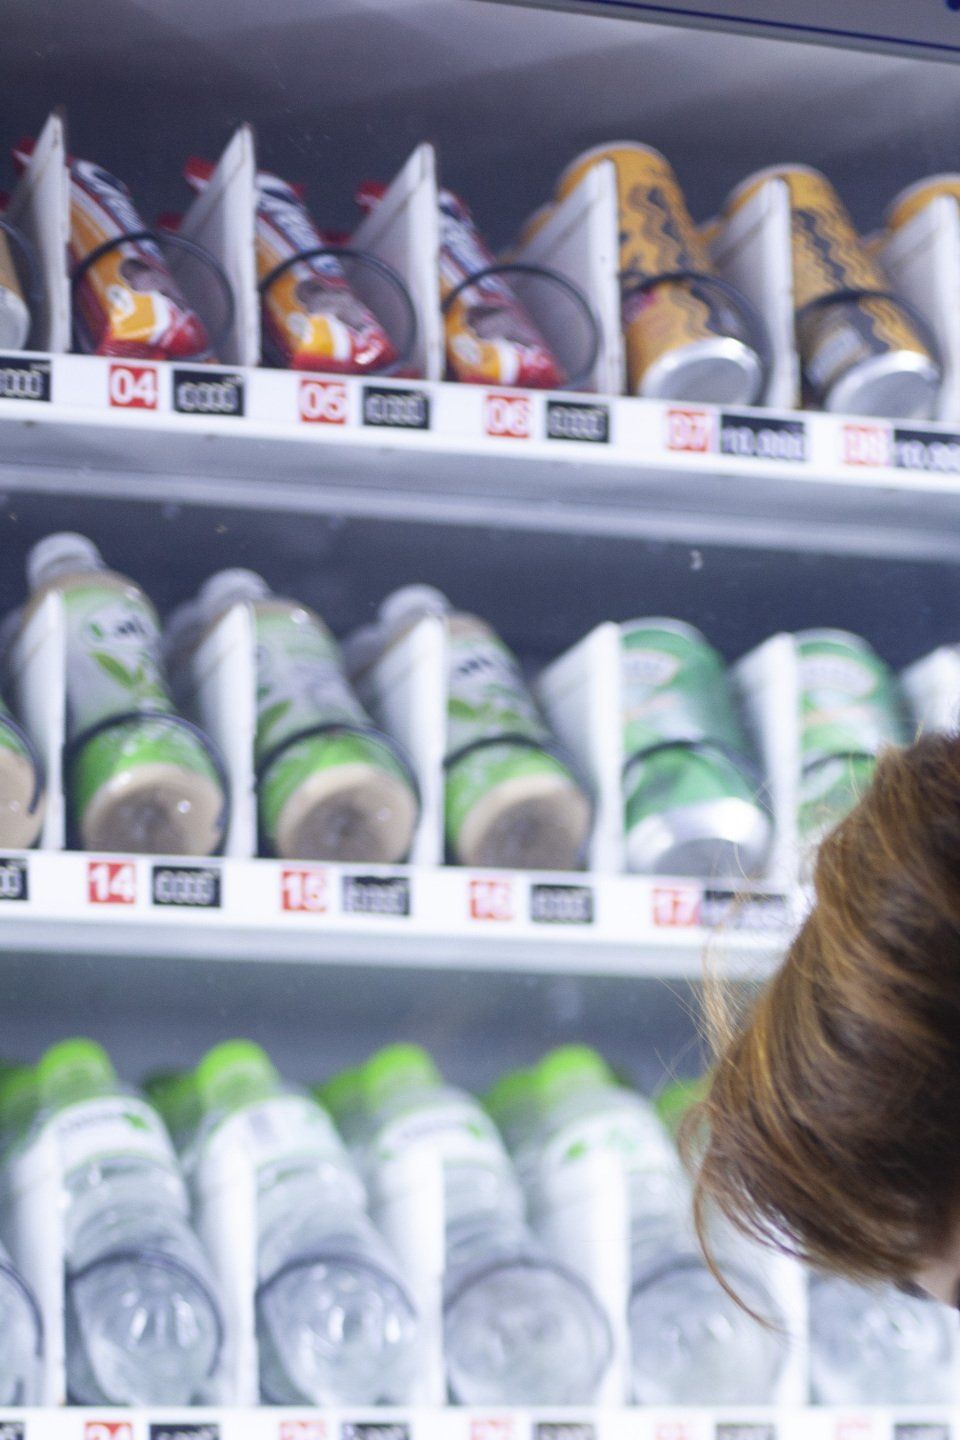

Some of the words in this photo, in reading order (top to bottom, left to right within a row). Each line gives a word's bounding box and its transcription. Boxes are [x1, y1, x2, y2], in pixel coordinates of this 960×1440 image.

[112, 367, 157, 408] 04
[301, 381, 345, 423] 05
[90, 863, 134, 902] 14
